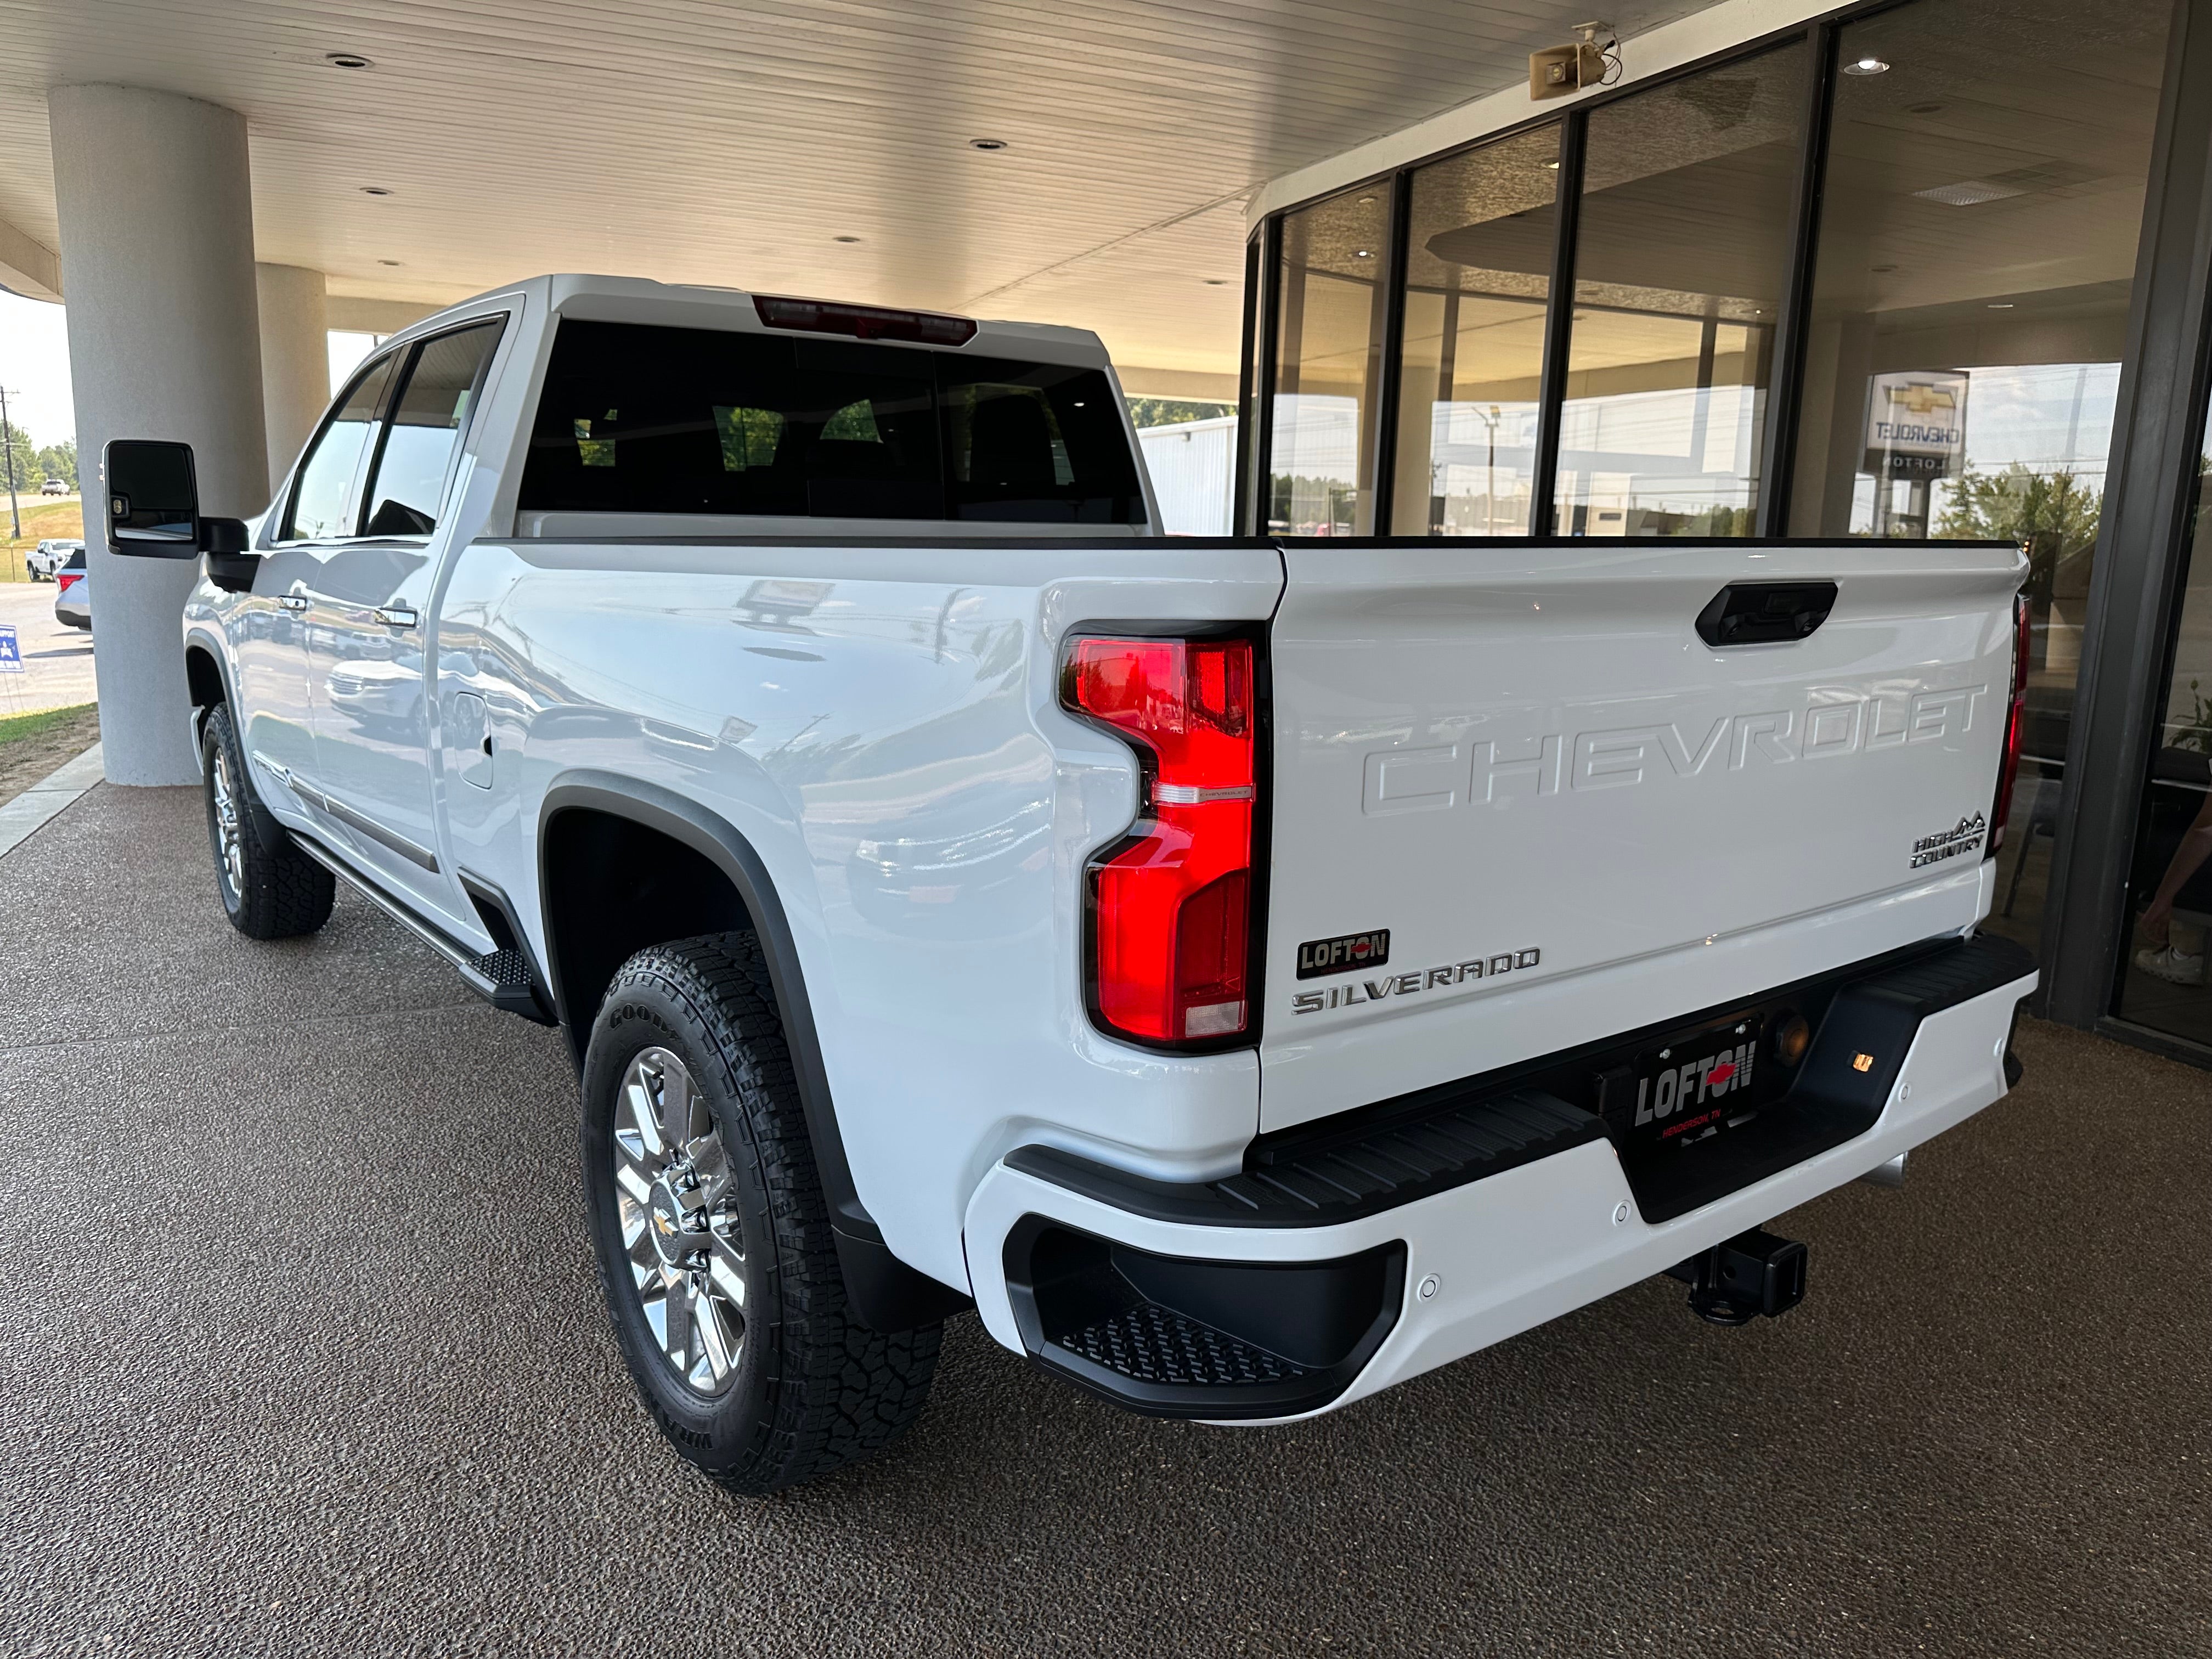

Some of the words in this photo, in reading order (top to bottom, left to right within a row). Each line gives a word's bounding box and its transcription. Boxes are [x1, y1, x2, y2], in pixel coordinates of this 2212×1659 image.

[1361, 684, 1988, 817] CHEVROLET
[1910, 834, 1983, 868] COUNTRY
[1912, 830, 1953, 854] HIGH
[1301, 933, 1386, 970] LOFTON
[1291, 946, 1541, 1016] SILVERADO
[1635, 1041, 1756, 1127] LOFTON
[1711, 1109, 1721, 1120] TN
